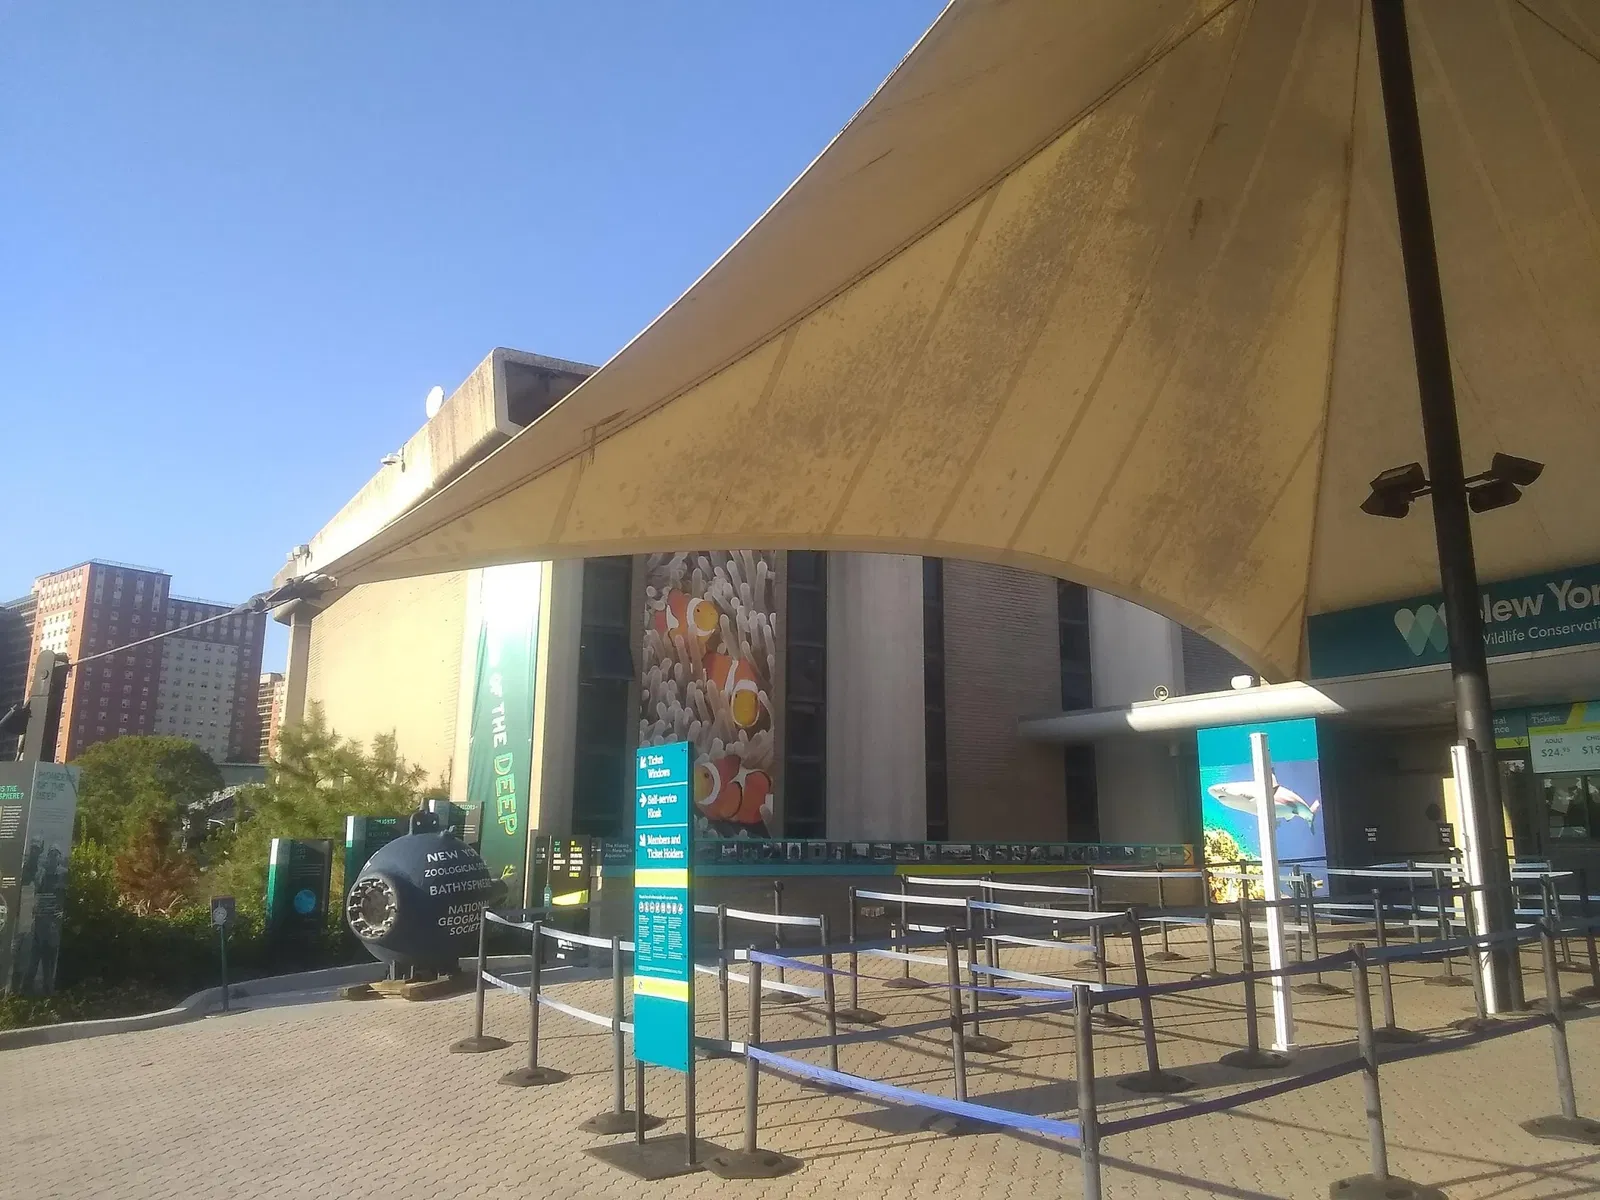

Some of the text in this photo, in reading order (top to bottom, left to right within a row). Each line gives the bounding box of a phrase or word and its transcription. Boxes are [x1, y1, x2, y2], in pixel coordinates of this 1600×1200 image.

[491, 701, 507, 748] THE
[1530, 715, 1561, 725] Tickets
[648, 755, 664, 766] Ticket
[648, 768, 671, 779] Windows
[493, 752, 518, 835] DEEP
[647, 794, 678, 805] Self-service
[647, 808, 662, 818] Kiosk
[647, 834, 681, 845] Members and
[427, 850, 458, 863] NEW
[647, 847, 684, 859] Ticket Holders
[424, 862, 476, 878] ZOOLOGICAL
[429, 878, 492, 896] BATHYSPHERE
[438, 913, 481, 927] GEOGRA
